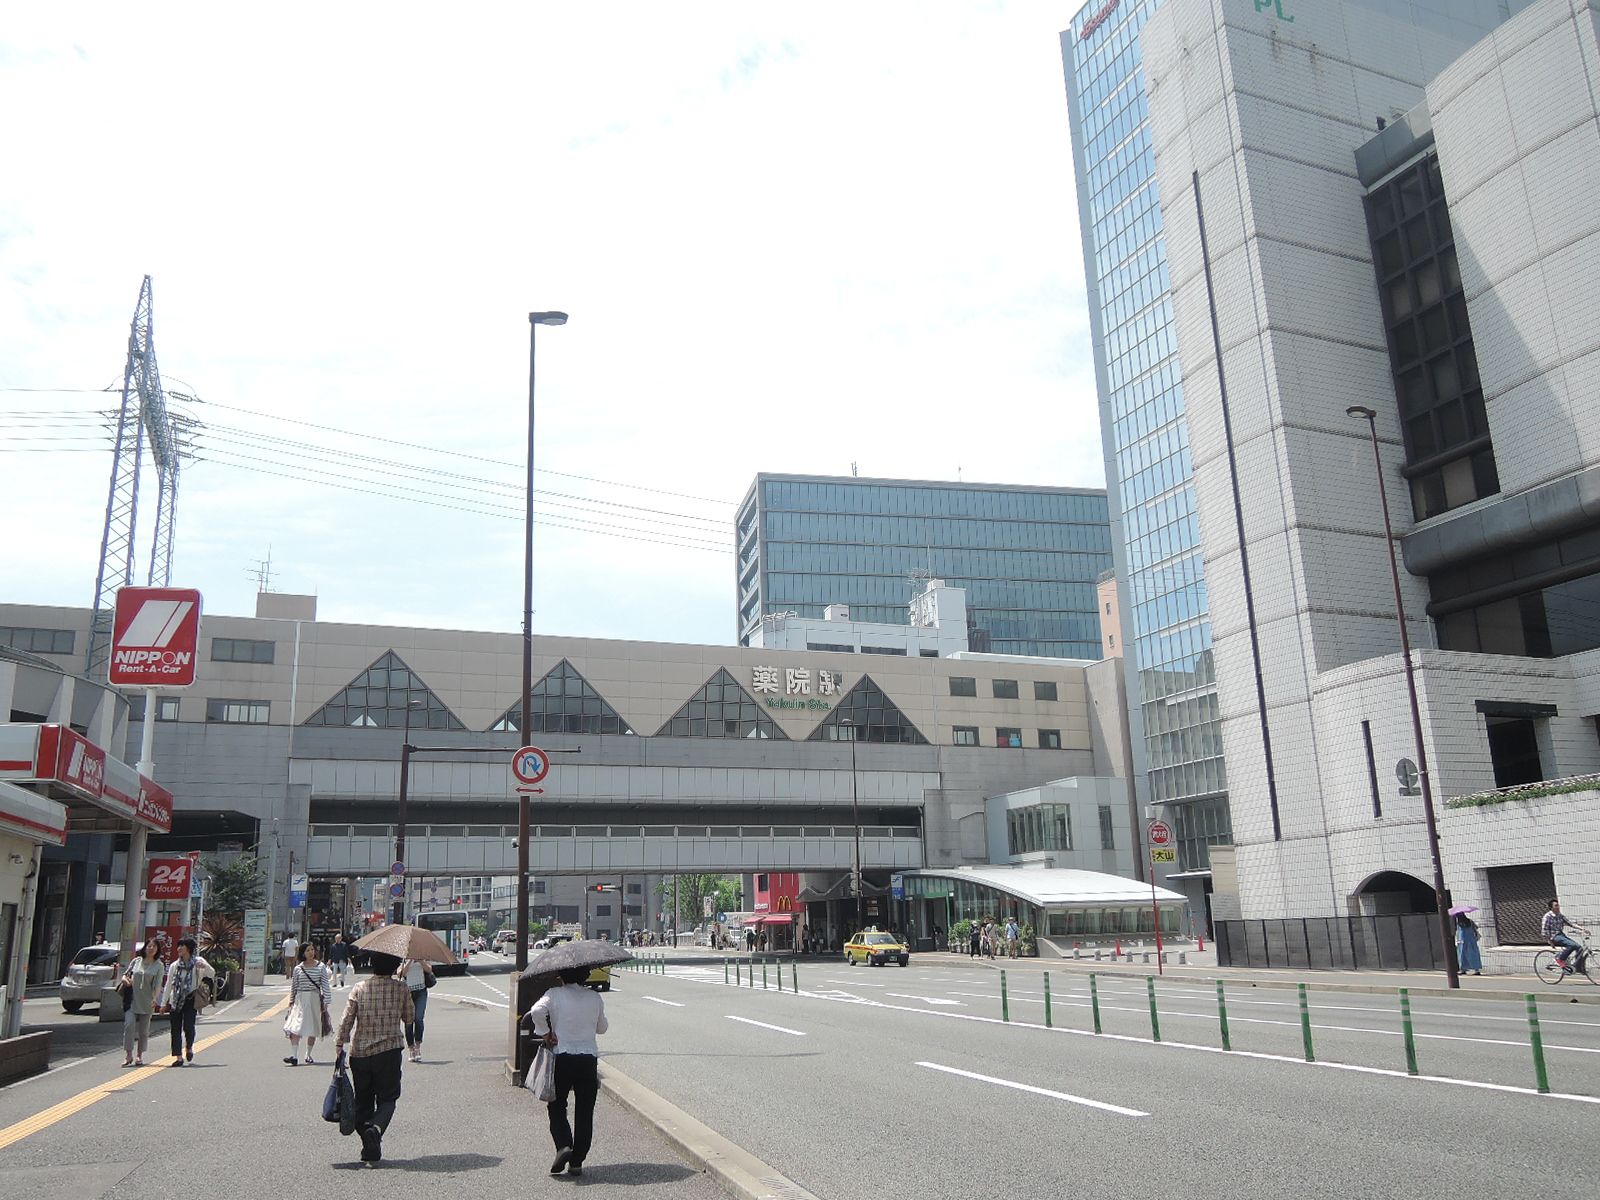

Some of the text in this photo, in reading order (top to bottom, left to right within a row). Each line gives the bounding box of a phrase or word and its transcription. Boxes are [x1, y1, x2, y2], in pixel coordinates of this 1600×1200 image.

[114, 651, 191, 665] NIPPON
[752, 665, 844, 697] 薬院駅
[766, 697, 805, 710] Yakuin
[151, 865, 187, 884] 24
[154, 884, 181, 894] Hours
